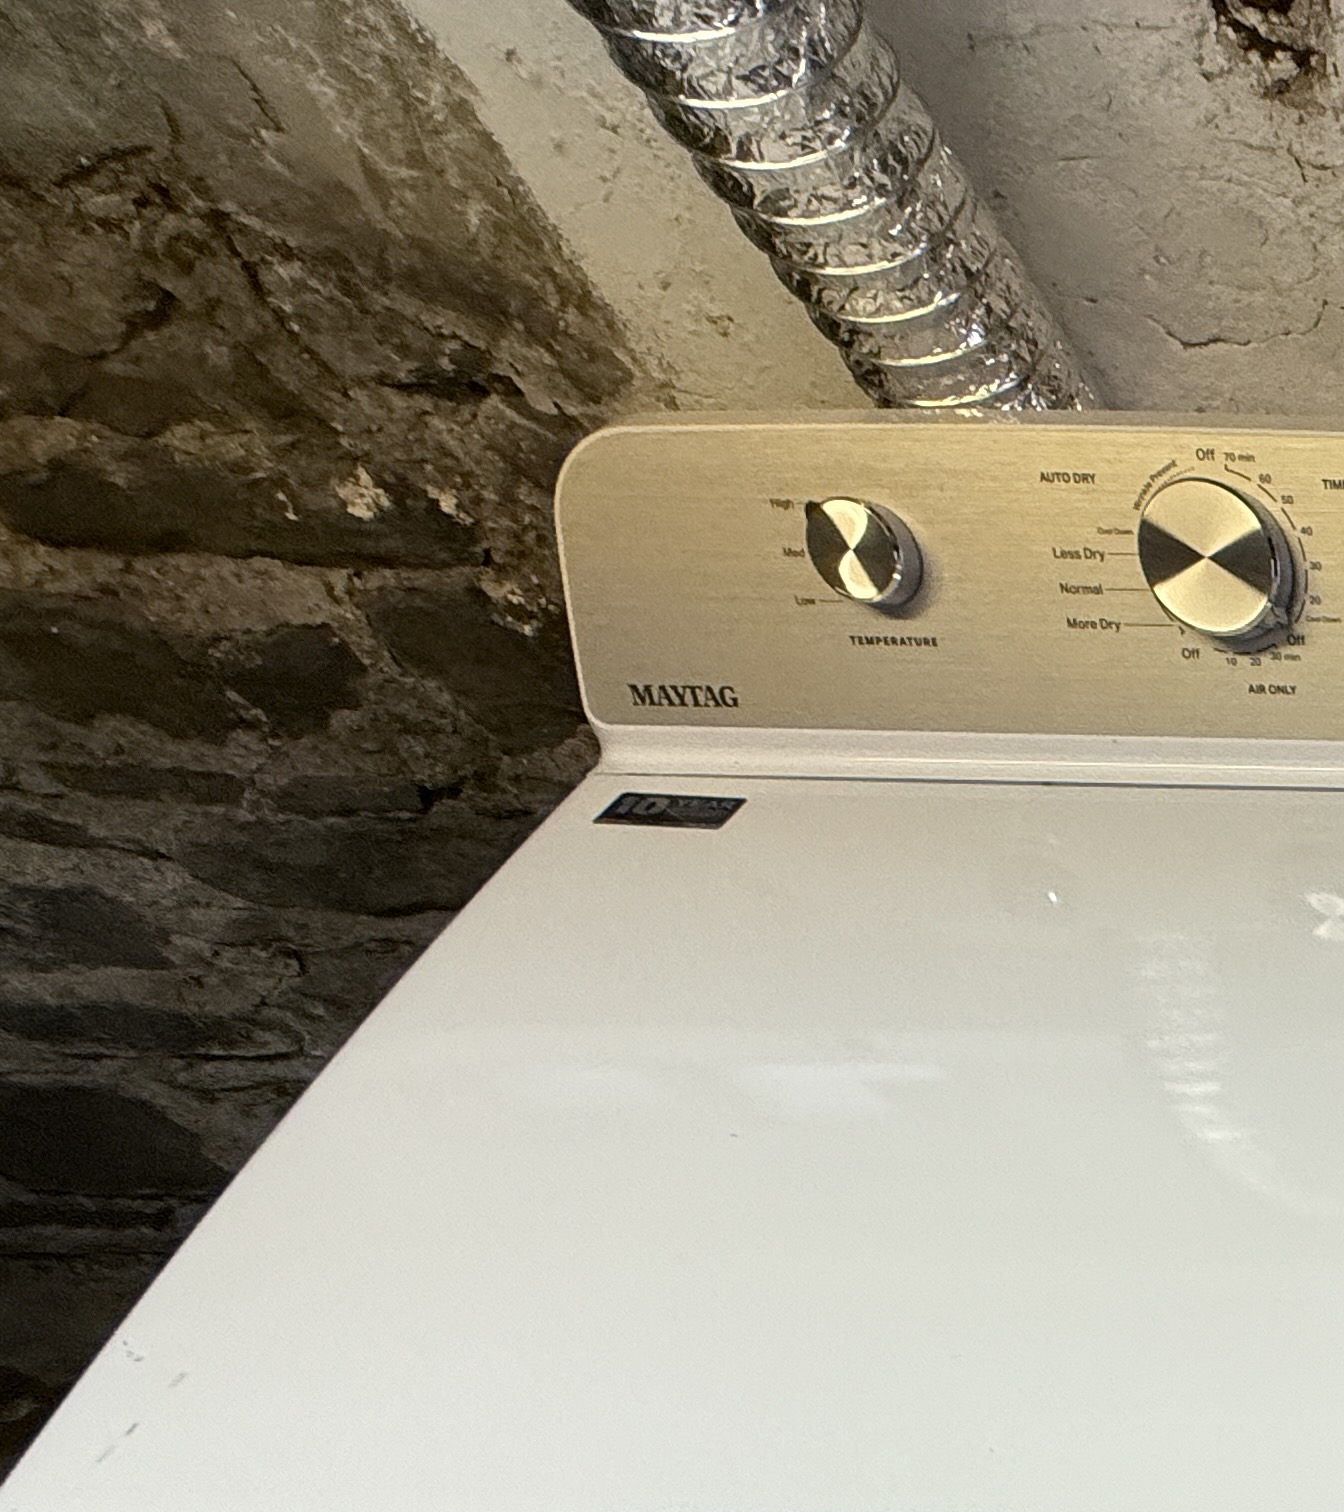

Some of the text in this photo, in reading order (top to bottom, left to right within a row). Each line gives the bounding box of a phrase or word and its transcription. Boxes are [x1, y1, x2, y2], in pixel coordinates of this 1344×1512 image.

[1195, 448, 1215, 461] Off
[1040, 472, 1096, 485] AUTO DRY
[1258, 474, 1272, 484] 60
[1281, 495, 1294, 506] 50
[1300, 526, 1313, 536] 40
[1052, 547, 1106, 562] Less Dry
[1059, 583, 1104, 595] Normal
[1066, 618, 1122, 633] More Dry
[849, 634, 939, 648] TEMPERATURE
[1286, 634, 1306, 646] Off
[1181, 648, 1200, 660] Off
[1248, 683, 1297, 695] AIR ONLY
[627, 683, 740, 708] MAYTAG
